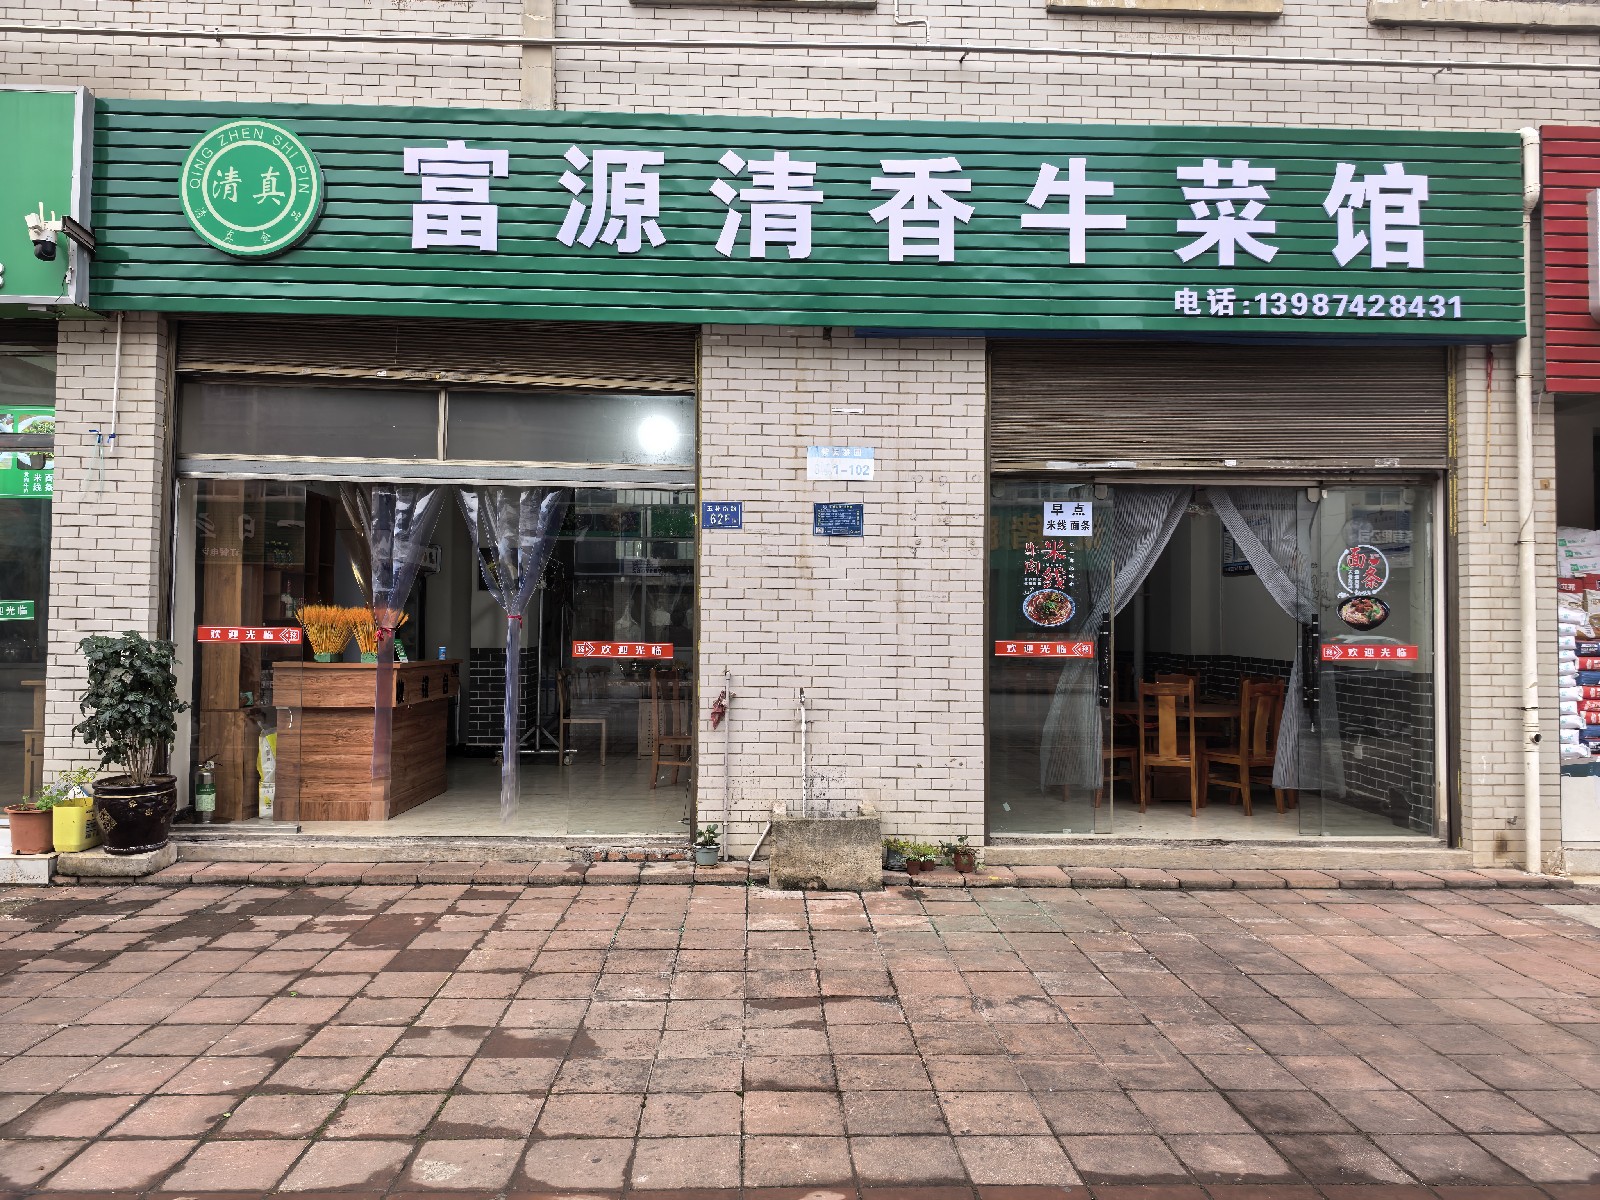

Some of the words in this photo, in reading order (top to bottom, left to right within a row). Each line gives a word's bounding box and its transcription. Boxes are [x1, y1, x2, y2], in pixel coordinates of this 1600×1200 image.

[190, 147, 213, 189] QING
[217, 127, 264, 147] ZHEN
[272, 135, 299, 159] SHI
[295, 165, 310, 194] PIN
[212, 166, 286, 206] 清真
[403, 140, 1430, 270] 富源清香牛菜馆
[1174, 287, 1463, 318] 电话:13987428431
[1051, 503, 1086, 516] 早点
[1046, 520, 1067, 531] 米线
[1070, 520, 1090, 531] 面条
[1347, 547, 1384, 589] 面条
[210, 629, 274, 640] 欢迎光临
[601, 645, 662, 656] 欢迎光临
[1006, 644, 1067, 654] 欢迎光临
[1347, 647, 1407, 658] 欢迎光临
